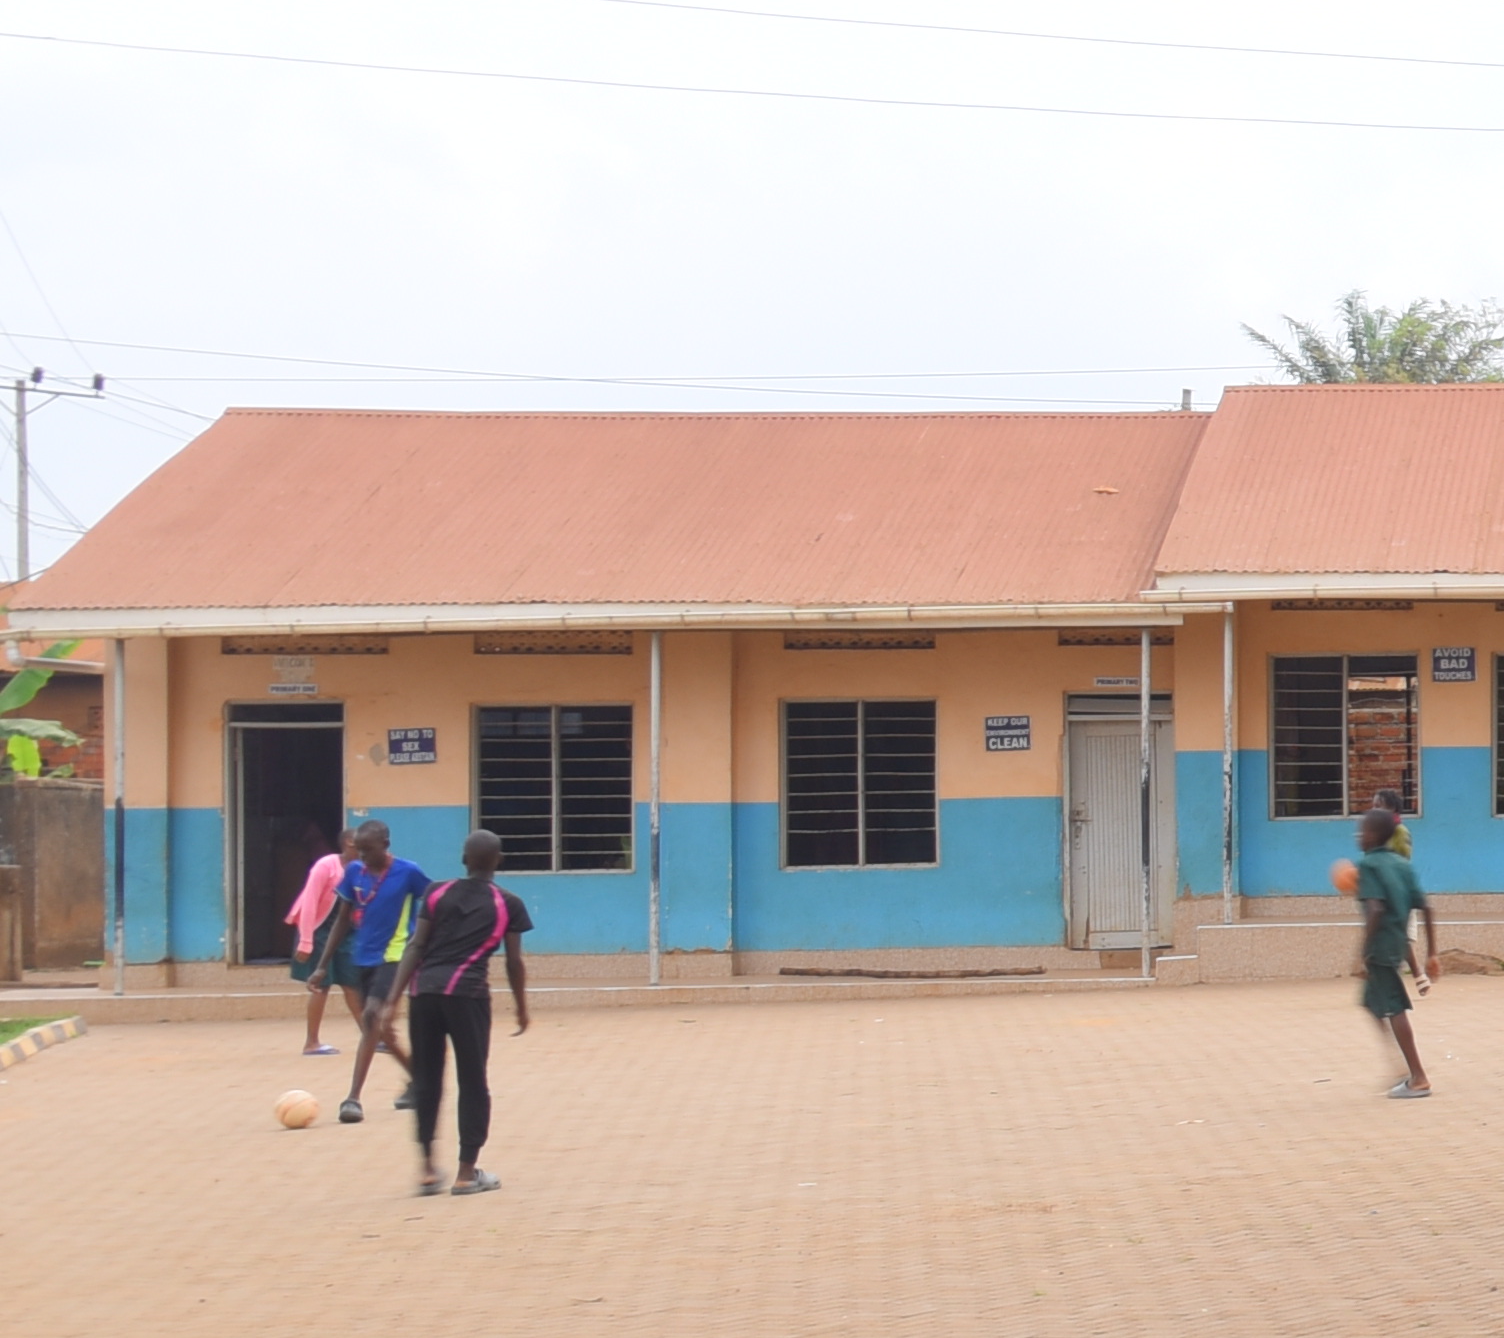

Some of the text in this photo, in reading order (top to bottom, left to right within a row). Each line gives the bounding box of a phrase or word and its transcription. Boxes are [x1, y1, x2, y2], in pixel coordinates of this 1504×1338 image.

[1435, 648, 1472, 657] AVOID
[1440, 658, 1468, 669] BAD
[1434, 671, 1472, 681] TOUCHES
[987, 717, 1028, 727] KEEP OUR
[390, 729, 433, 740] SAY NO TO
[402, 741, 420, 751] SEX
[988, 736, 1028, 749] CLEAN
